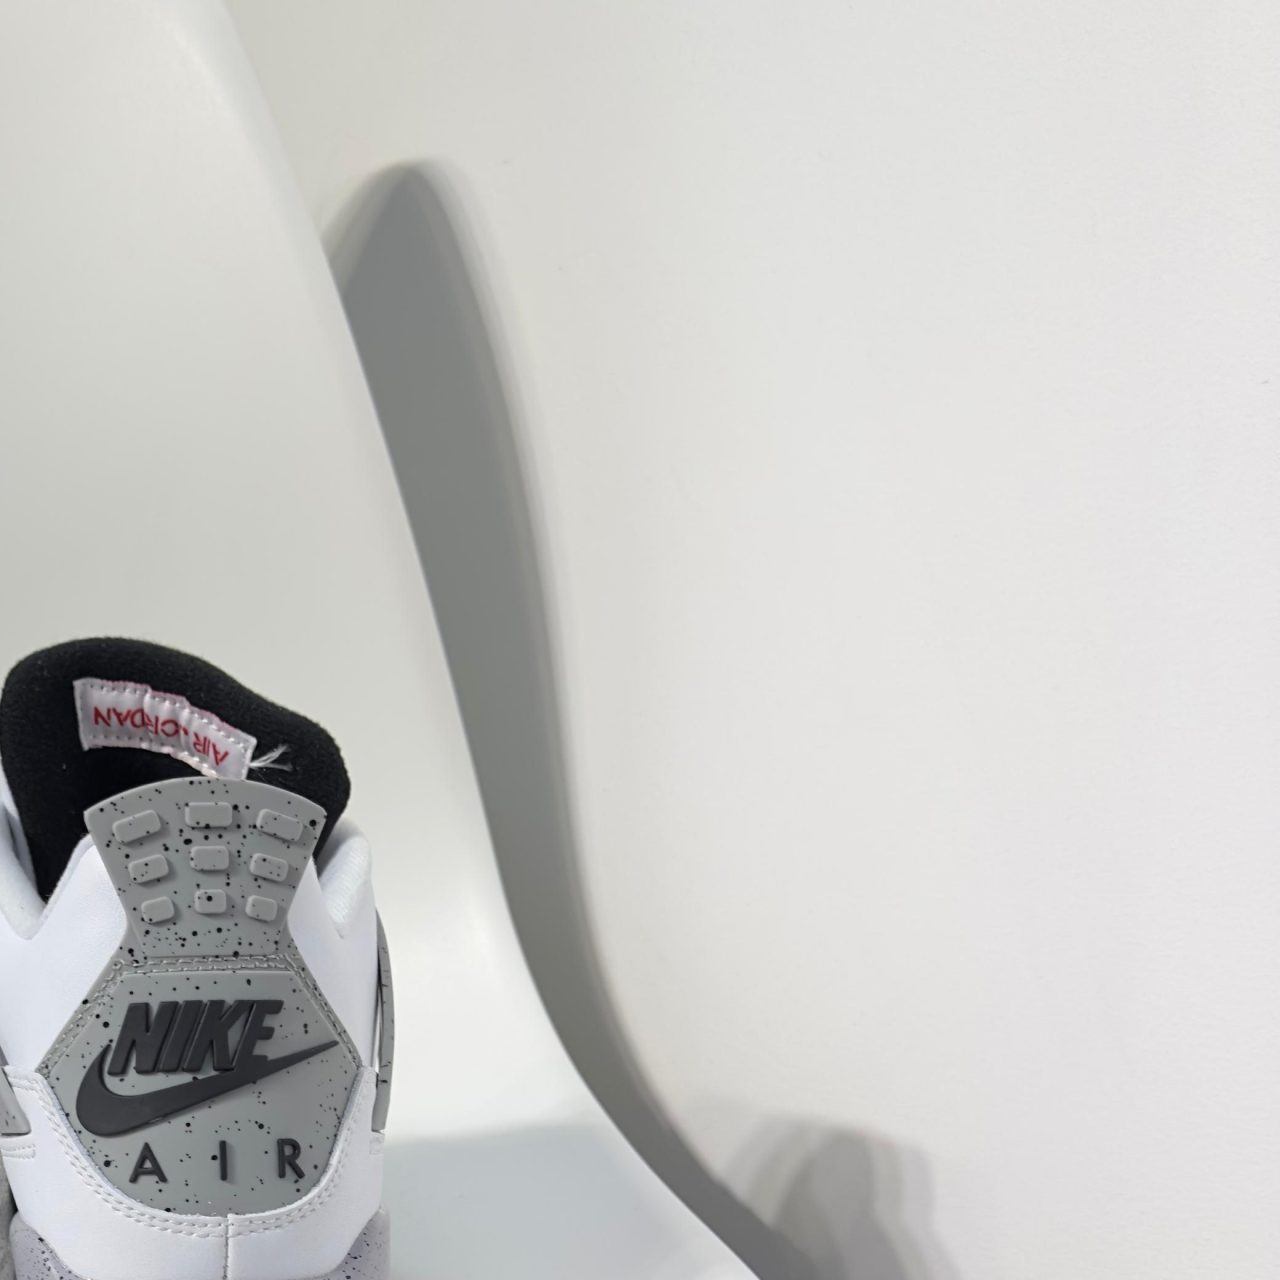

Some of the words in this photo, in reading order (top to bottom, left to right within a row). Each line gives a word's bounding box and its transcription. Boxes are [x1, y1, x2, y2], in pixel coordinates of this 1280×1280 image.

[193, 731, 230, 766] AIR
[109, 999, 284, 1076] NIKE
[127, 1138, 306, 1184] AIR
